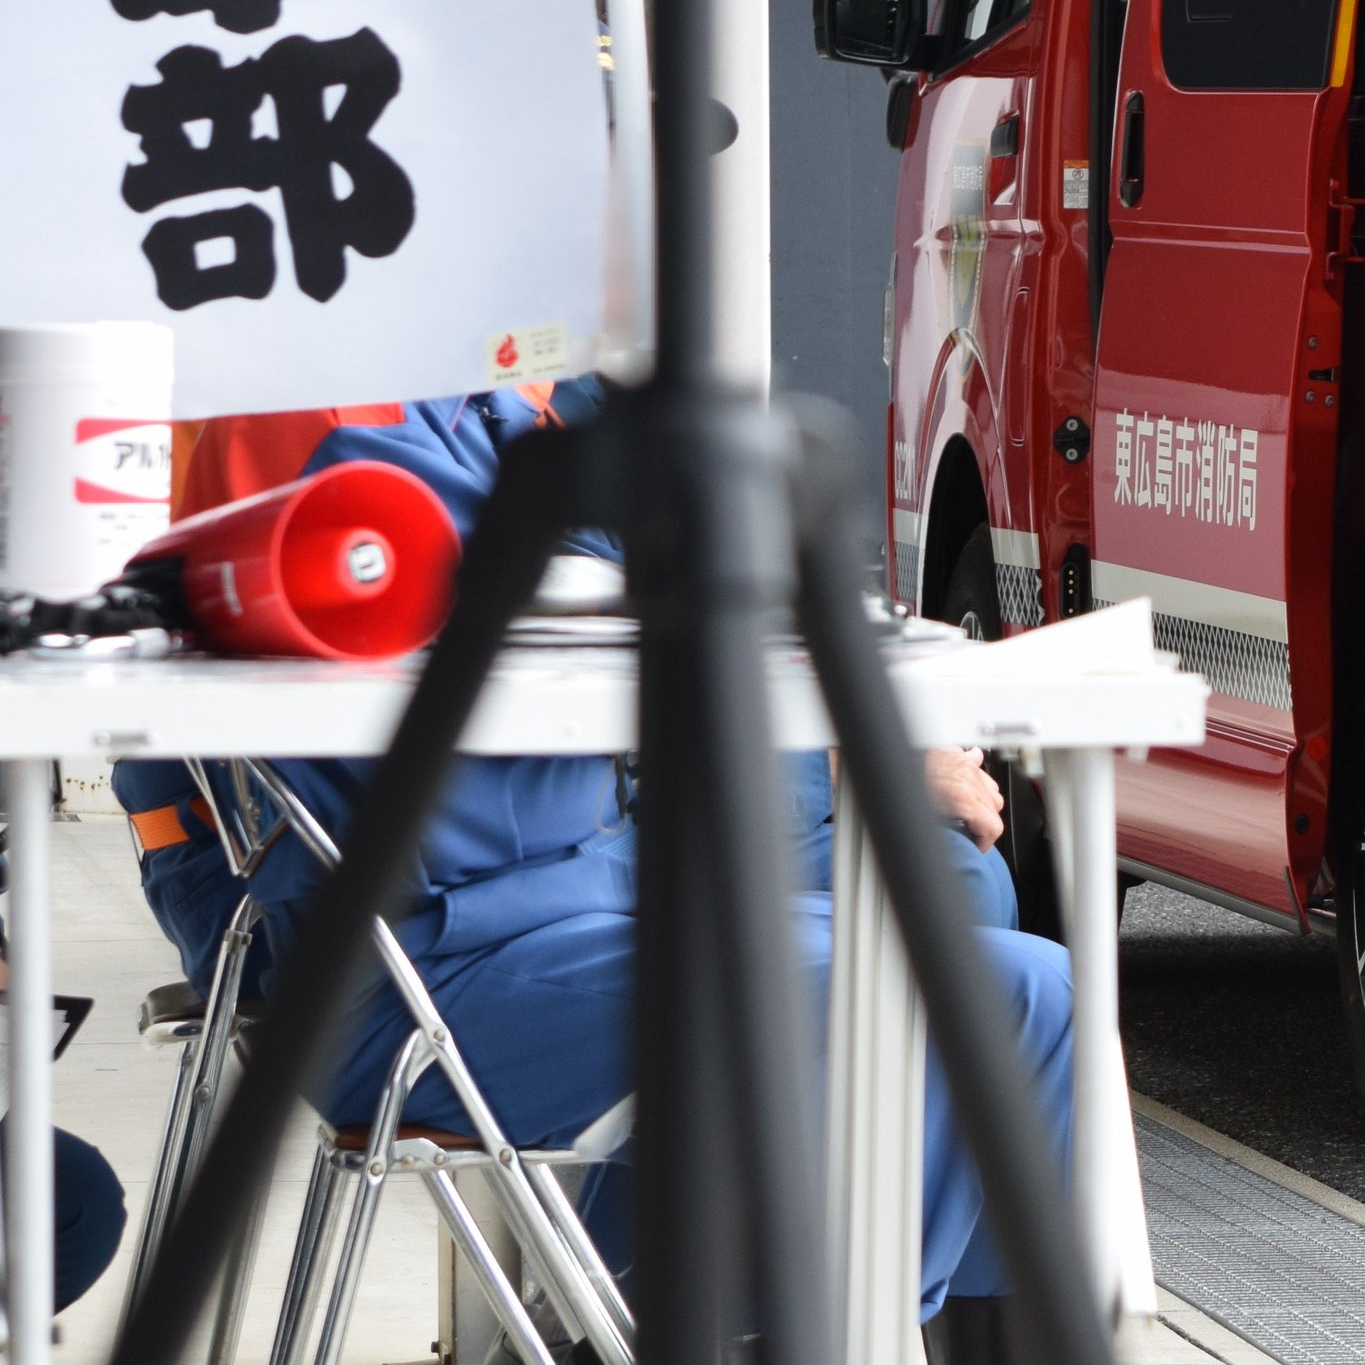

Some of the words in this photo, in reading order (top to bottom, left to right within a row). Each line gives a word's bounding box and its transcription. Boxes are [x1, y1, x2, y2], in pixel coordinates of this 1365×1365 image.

[1114, 407, 1258, 532] 東広島市消防局
